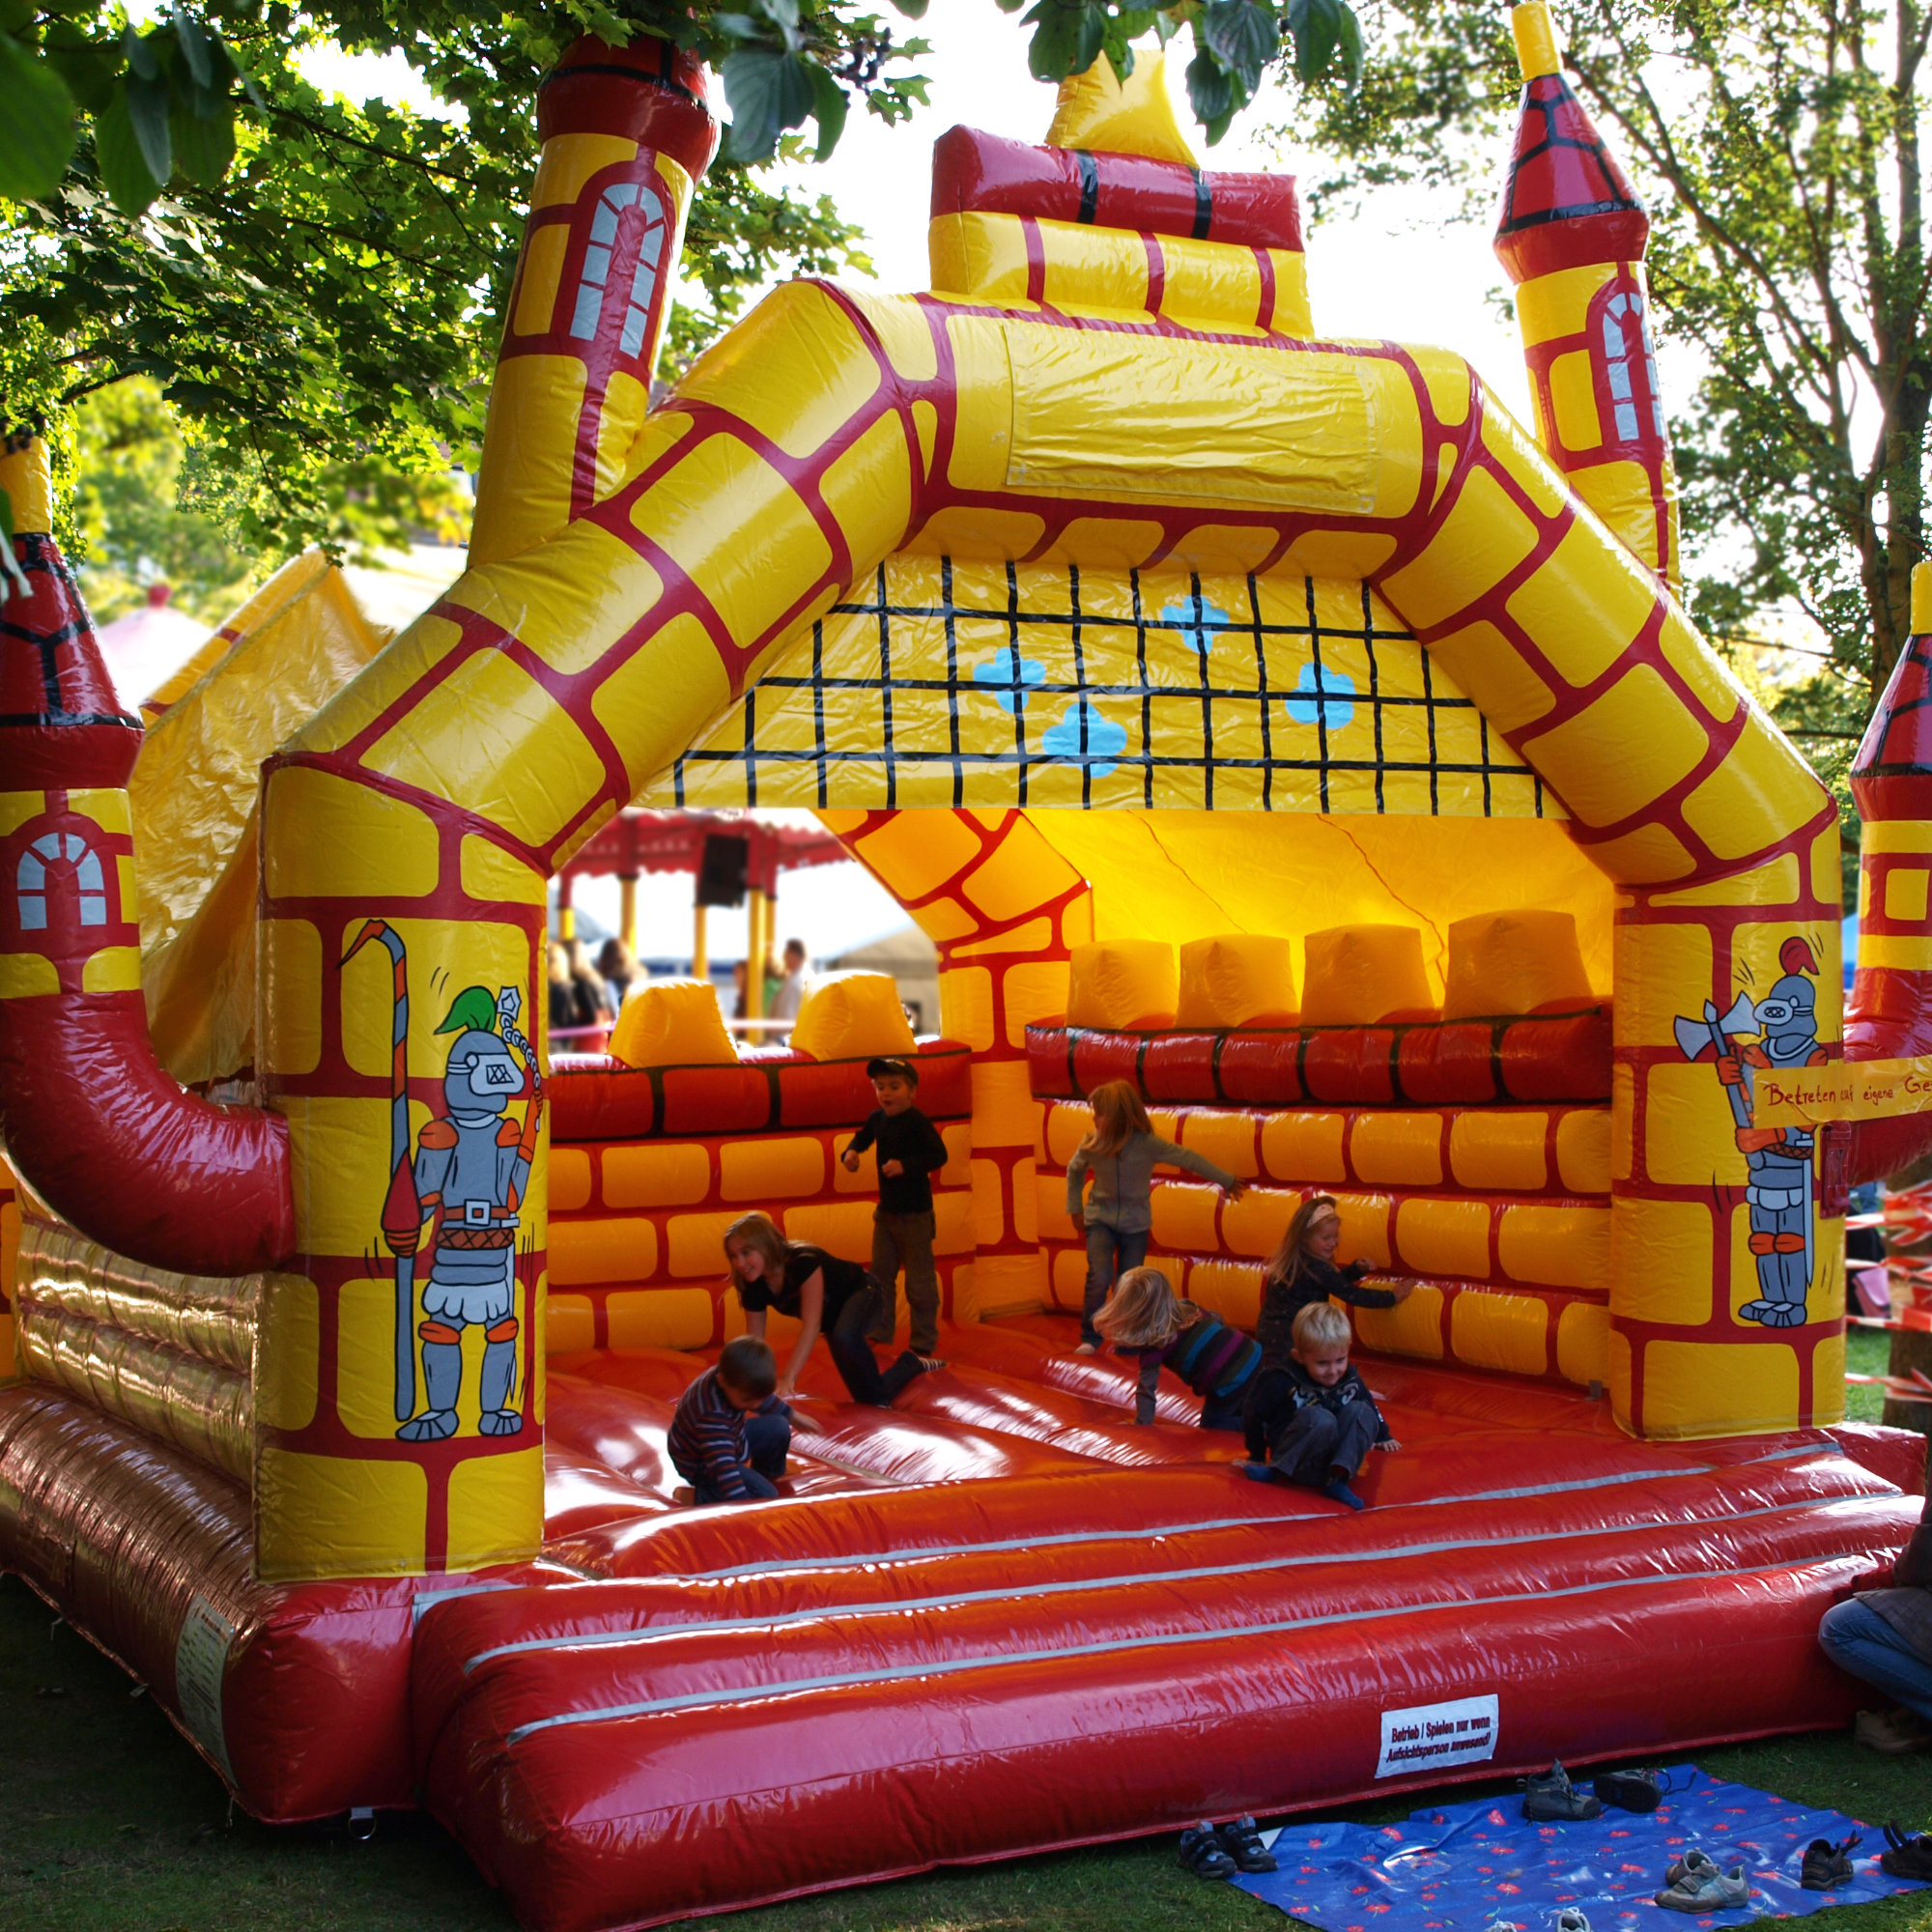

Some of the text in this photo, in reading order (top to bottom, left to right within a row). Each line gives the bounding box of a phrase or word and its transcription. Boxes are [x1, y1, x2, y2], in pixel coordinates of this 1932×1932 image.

[1763, 1083, 1835, 1106] Betreten
[1863, 1085, 1893, 1106] eigene
[1392, 1724, 1420, 1743] Betrieb
[1426, 1719, 1454, 1741] Spielen
[1456, 1719, 1468, 1733] nur
[1470, 1717, 1491, 1730] wenn
[1386, 1745, 1449, 1763] Aufsichtsperson
